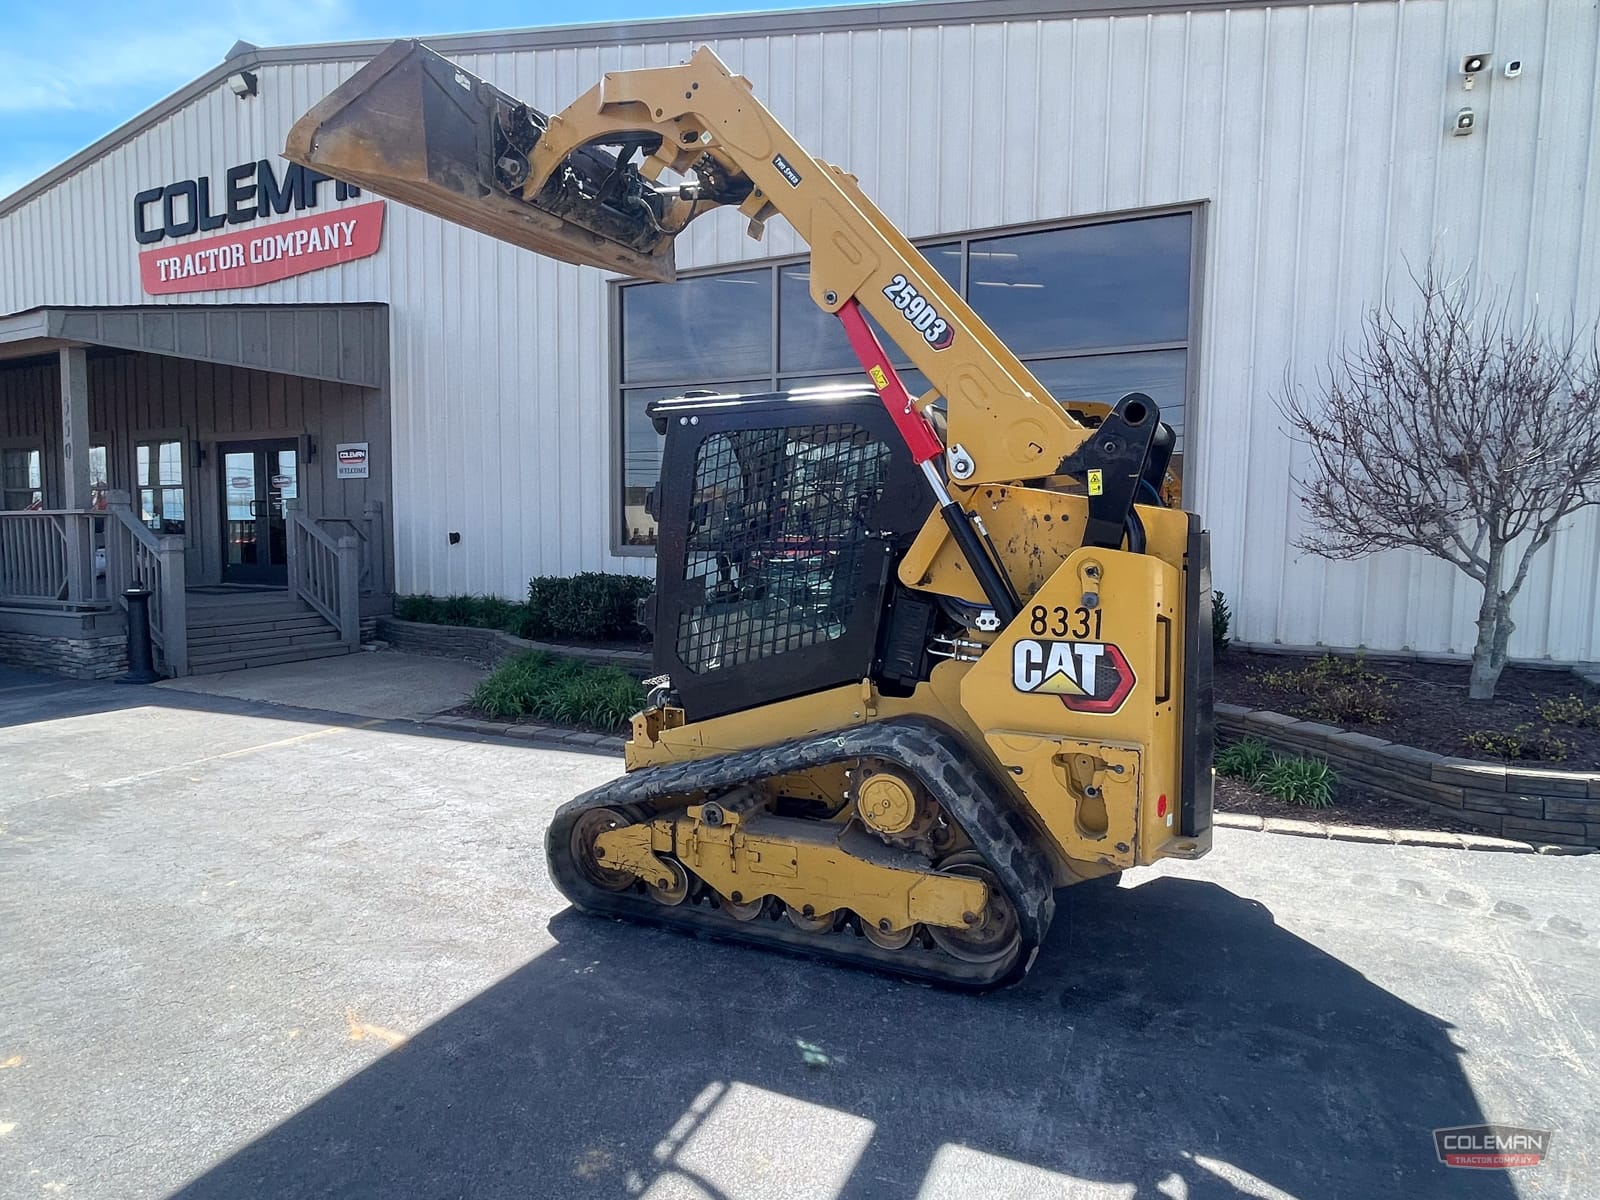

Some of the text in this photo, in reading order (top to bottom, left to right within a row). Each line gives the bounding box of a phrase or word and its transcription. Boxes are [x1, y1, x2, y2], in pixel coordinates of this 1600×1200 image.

[157, 219, 358, 282] TRACTOR COMPANY
[883, 274, 947, 342] 259D3
[1030, 605, 1102, 640] 8331
[1014, 640, 1104, 696] CAT
